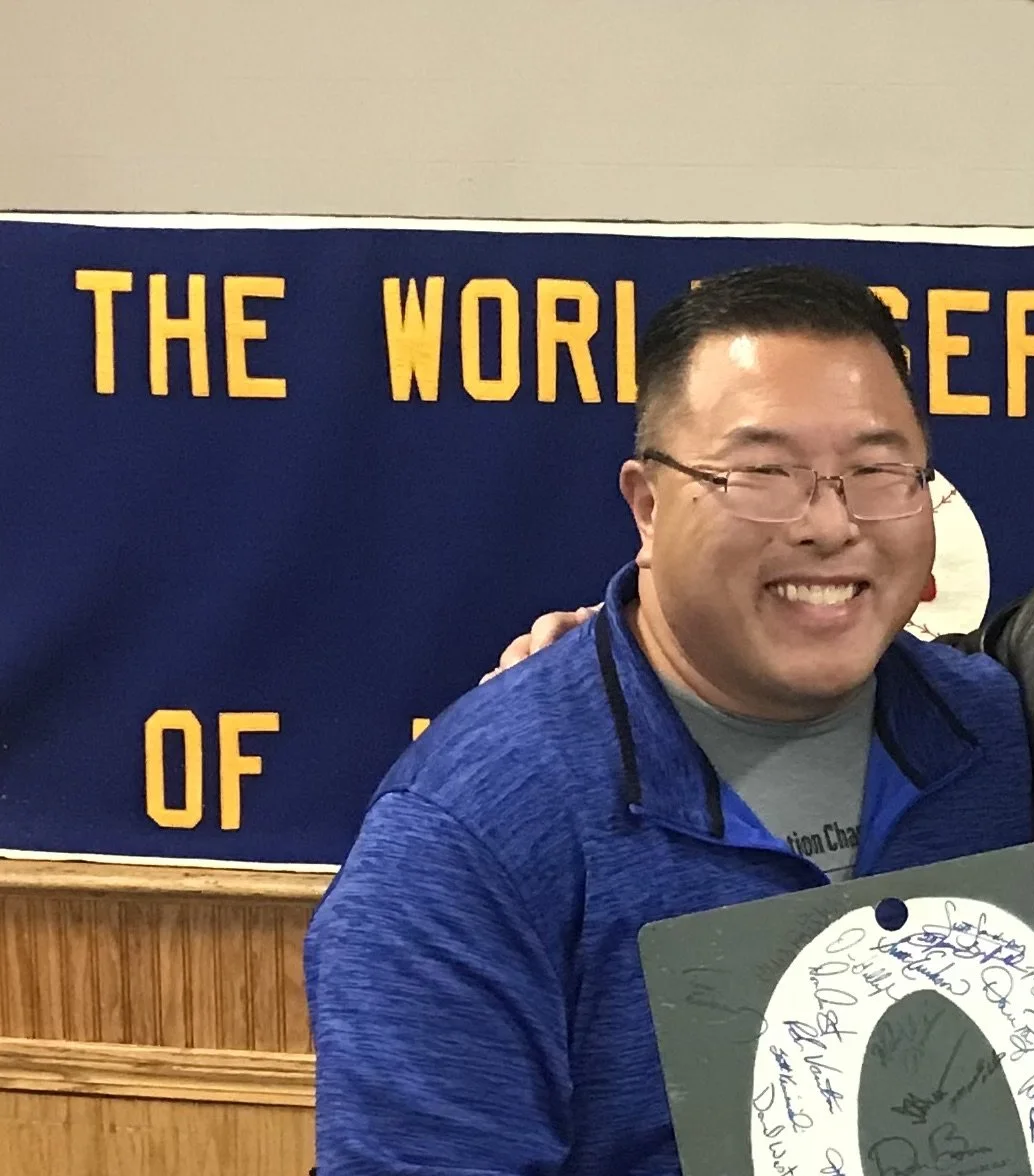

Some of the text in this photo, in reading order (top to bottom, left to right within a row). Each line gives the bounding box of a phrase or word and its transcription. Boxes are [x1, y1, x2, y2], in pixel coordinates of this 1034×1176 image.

[75, 270, 286, 398] THE
[144, 709, 280, 830] OF
[823, 821, 861, 851] Cha
